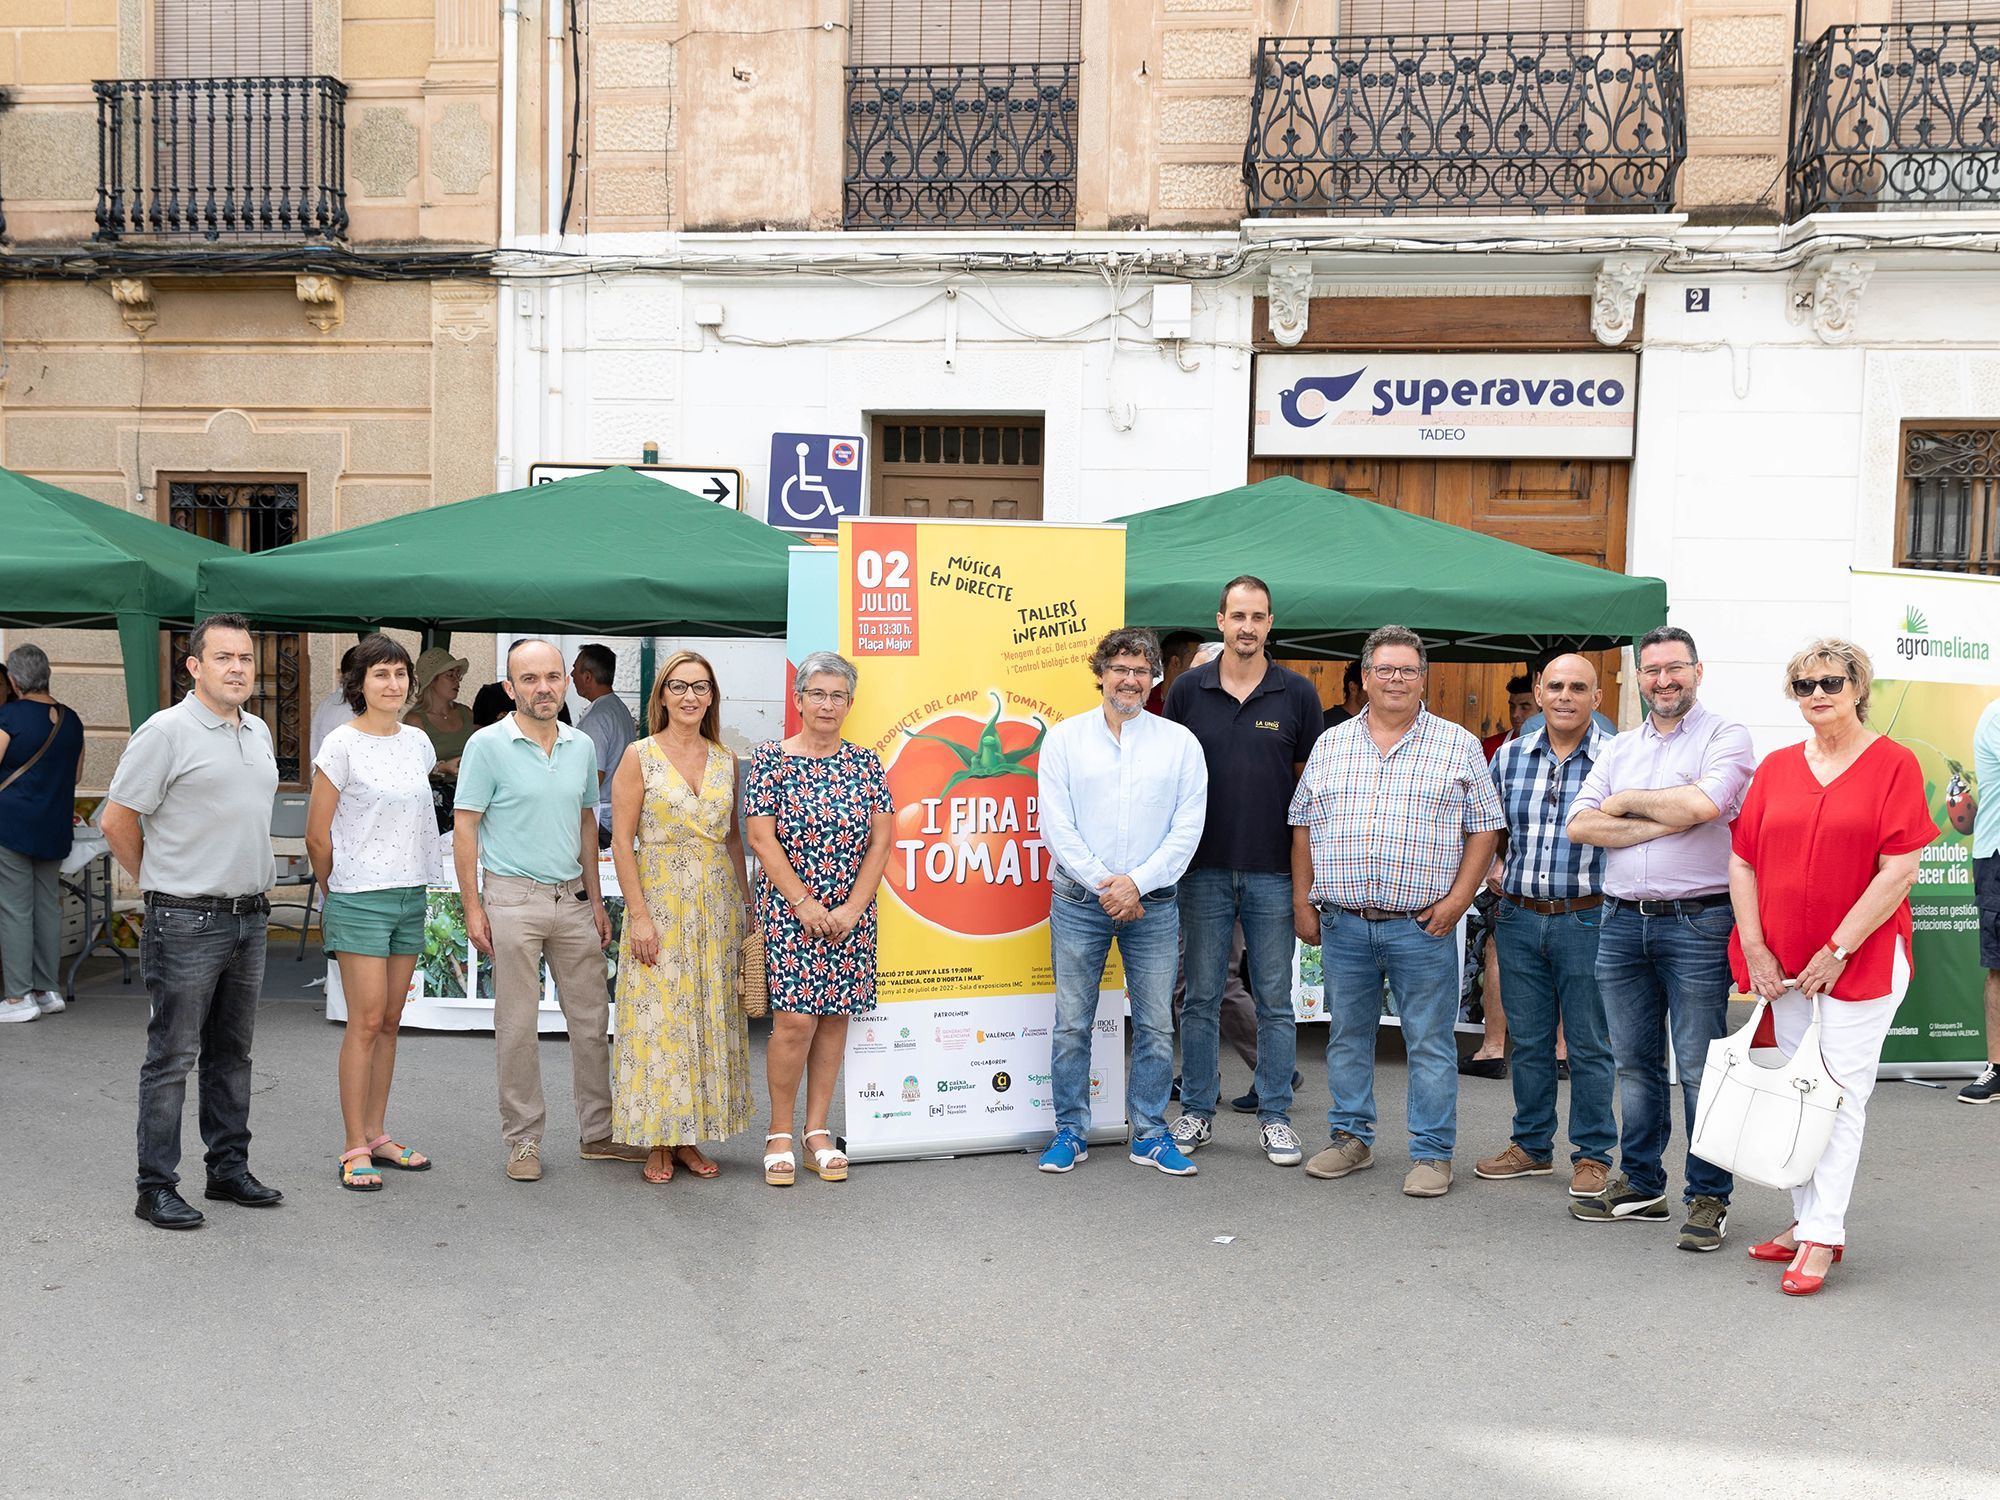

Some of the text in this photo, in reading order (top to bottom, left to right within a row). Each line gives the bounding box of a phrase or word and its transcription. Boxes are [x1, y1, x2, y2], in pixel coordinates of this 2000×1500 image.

[1690, 288, 1703, 310] 2
[1372, 378, 1624, 416] superavaco
[1419, 428, 1465, 441] TADEO
[857, 550, 911, 588] 02
[930, 572, 950, 586] EN
[858, 593, 912, 612] JULIOL
[1018, 600, 1077, 624] TALLERS
[859, 624, 912, 635] 10 a 13:30 h.
[859, 638, 912, 652] Plaça Major
[1056, 642, 1067, 651] Del
[1069, 640, 1088, 650] camp
[1090, 637, 1097, 646] al
[1897, 636, 1989, 660] agromeliana
[1042, 656, 1068, 670] biològic
[1071, 654, 1079, 663] de
[924, 700, 944, 714] DEL
[946, 690, 978, 704] CAMP
[1026, 796, 1038, 814] D
[921, 797, 1020, 834] I FIRA
[1918, 864, 1968, 884] ecer día
[1912, 904, 1978, 917] cialistas en gestión
[1912, 918, 1980, 932] plotaciones agrícol
[1888, 1026, 1918, 1036] omeliana
[1028, 1072, 1052, 1085] Schnei
[985, 1104, 1014, 1113] Agrobio
